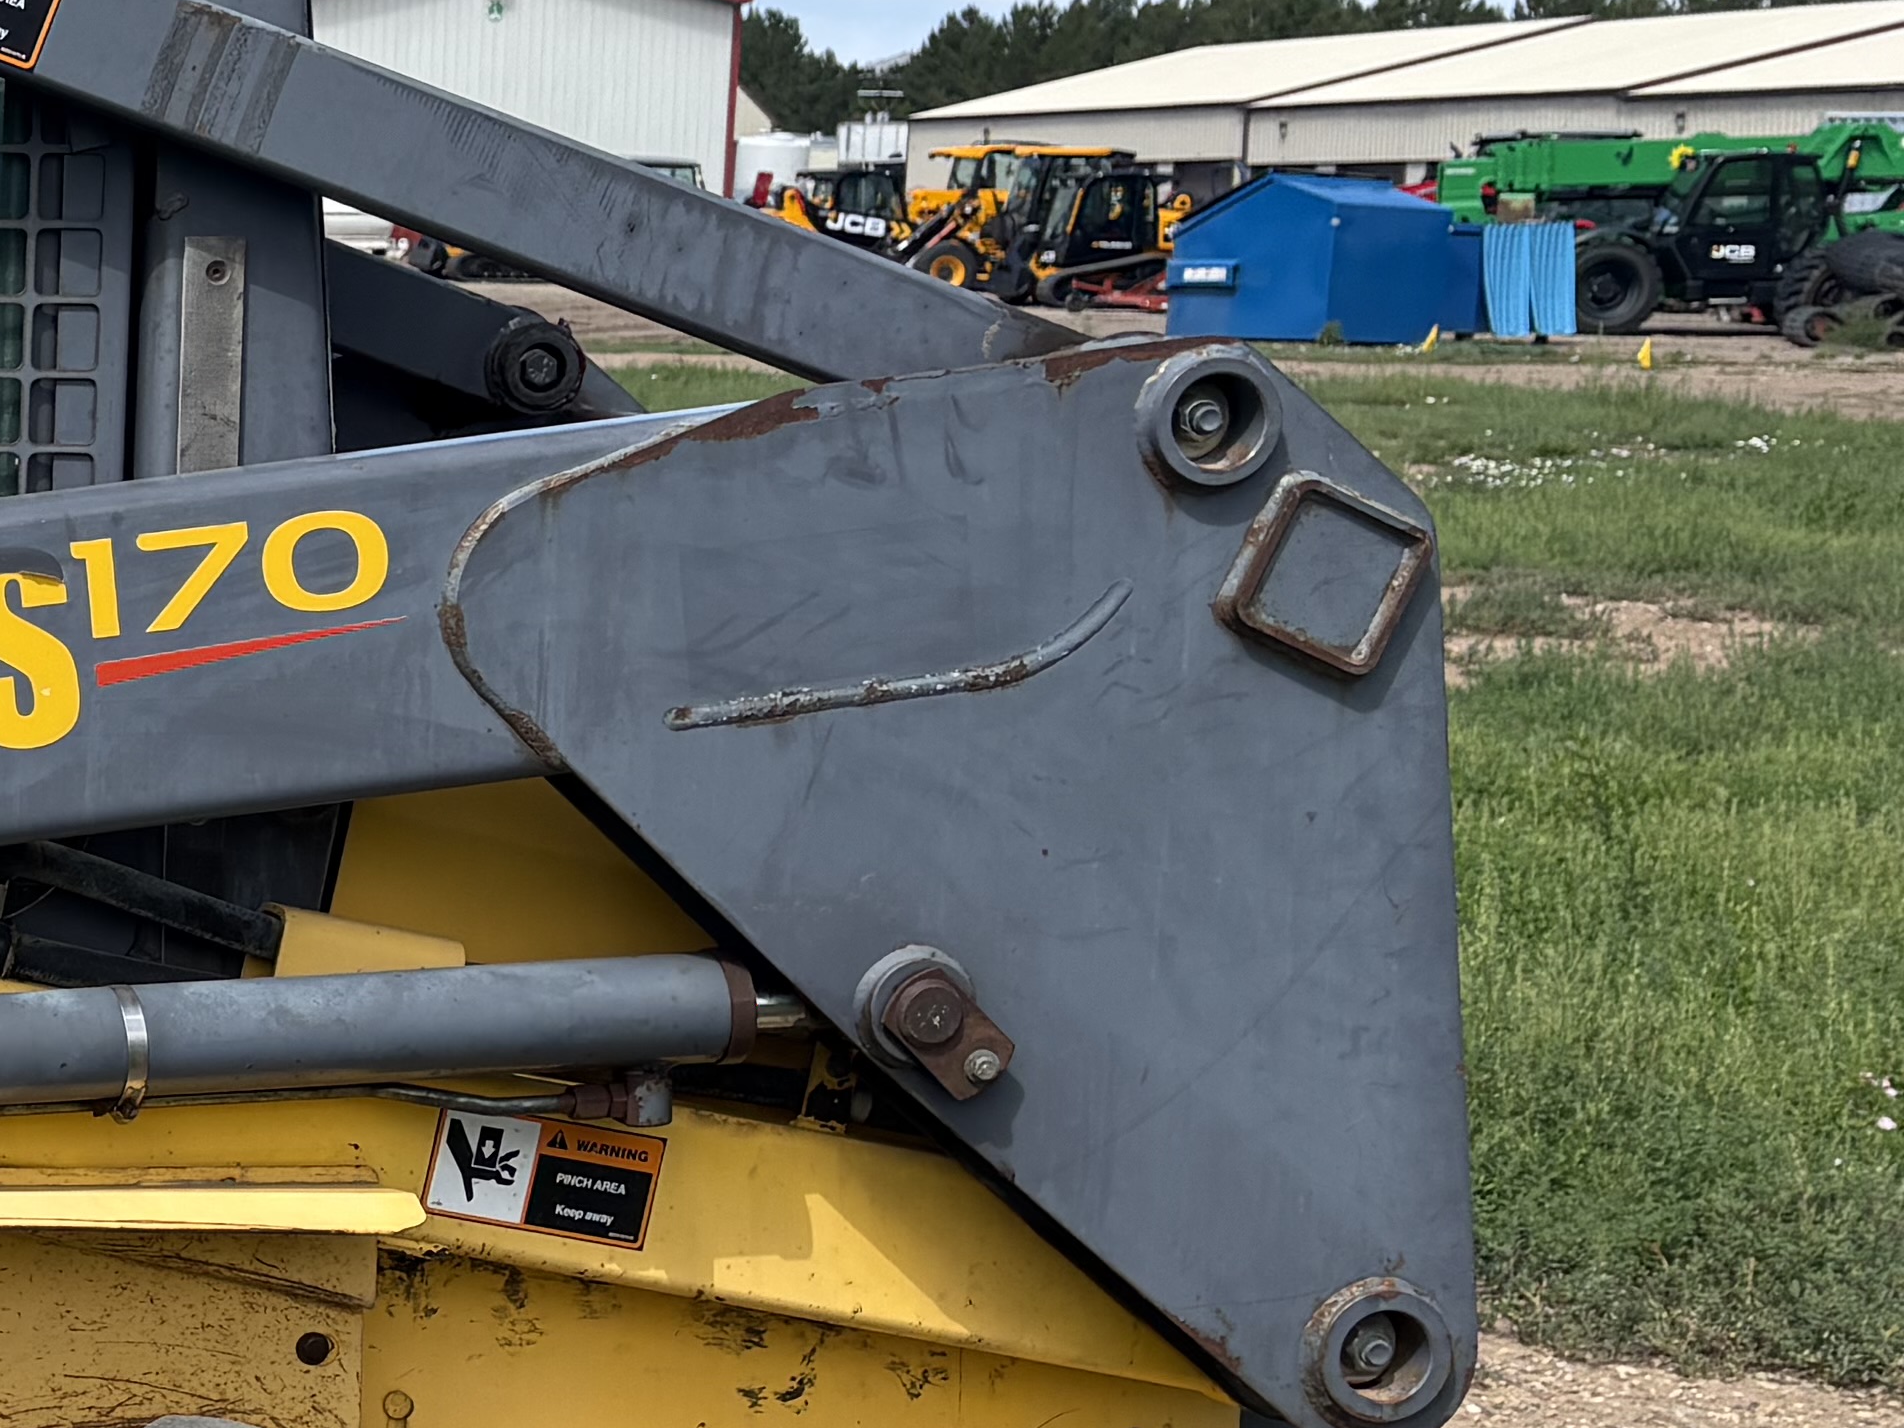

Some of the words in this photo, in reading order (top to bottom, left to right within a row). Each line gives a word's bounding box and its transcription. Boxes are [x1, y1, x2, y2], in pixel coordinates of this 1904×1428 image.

[825, 212, 886, 238] JCB
[1710, 244, 1756, 260] JCB
[576, 1139, 649, 1163] WARNING
[556, 1172, 592, 1189] PINCH
[593, 1179, 626, 1195] AREA
[555, 1203, 584, 1221] Keep
[584, 1211, 615, 1227] away
